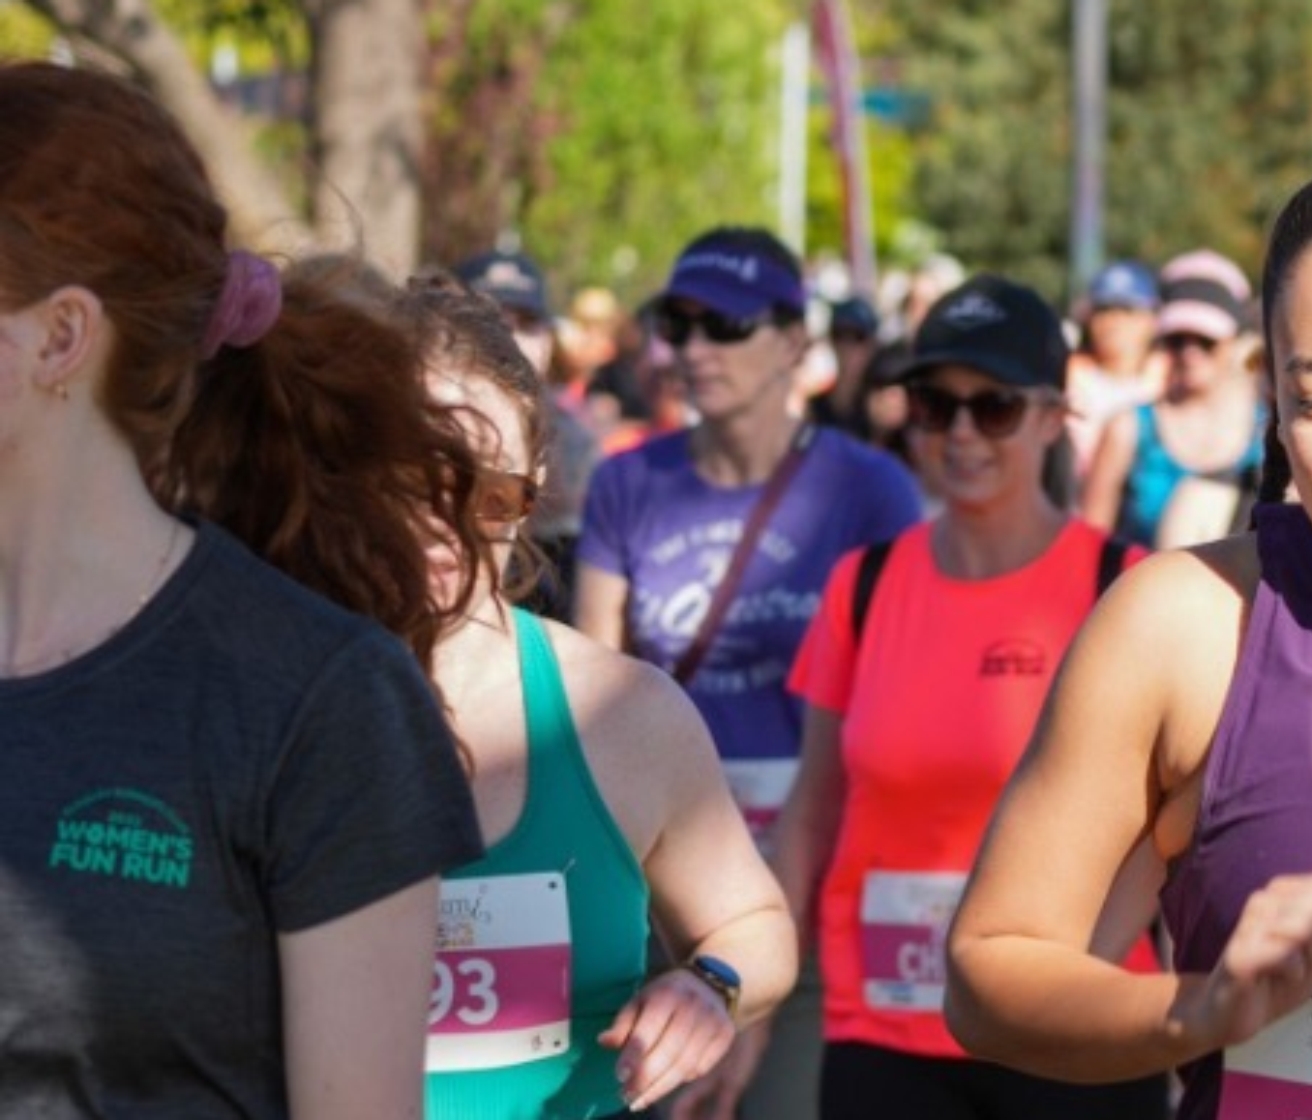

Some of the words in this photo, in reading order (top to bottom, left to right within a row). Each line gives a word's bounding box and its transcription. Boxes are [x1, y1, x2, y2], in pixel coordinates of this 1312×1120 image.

[57, 819, 193, 860] WOMEN'S
[49, 842, 117, 875] FUN
[122, 852, 190, 889] RUN
